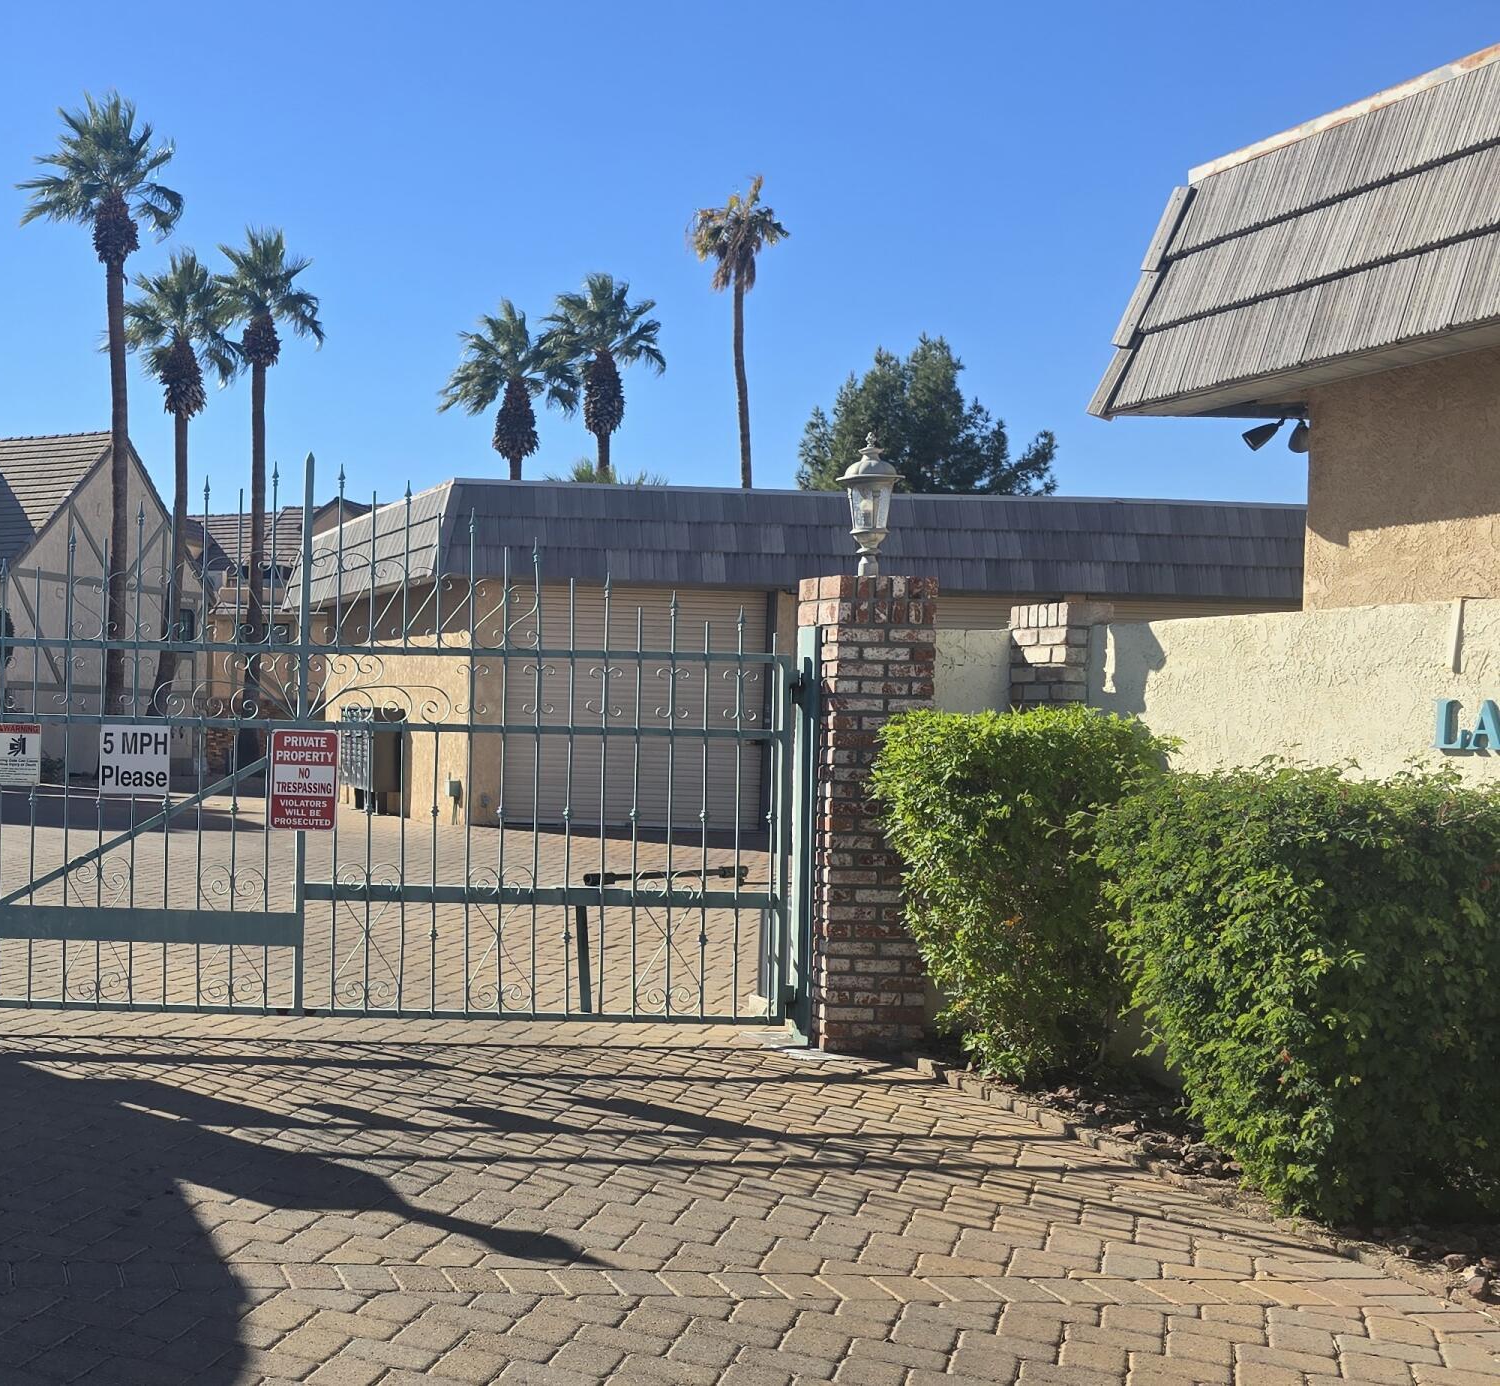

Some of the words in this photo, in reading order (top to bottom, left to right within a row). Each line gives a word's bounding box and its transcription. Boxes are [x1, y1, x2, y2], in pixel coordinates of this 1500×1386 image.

[3, 724, 38, 733] WARNING
[1429, 698, 1500, 751] LA
[103, 732, 114, 754] 5
[122, 732, 167, 755] MPH
[283, 736, 327, 748] PRIVATE
[276, 750, 334, 763] PROPERTY
[101, 765, 167, 787] Please
[298, 767, 310, 779] NO
[276, 782, 332, 794] TRESPASSING
[280, 799, 327, 807] VIOLATORS
[285, 808, 306, 816] WILL
[309, 809, 321, 817] BE
[274, 817, 331, 826] PROSECUTED
